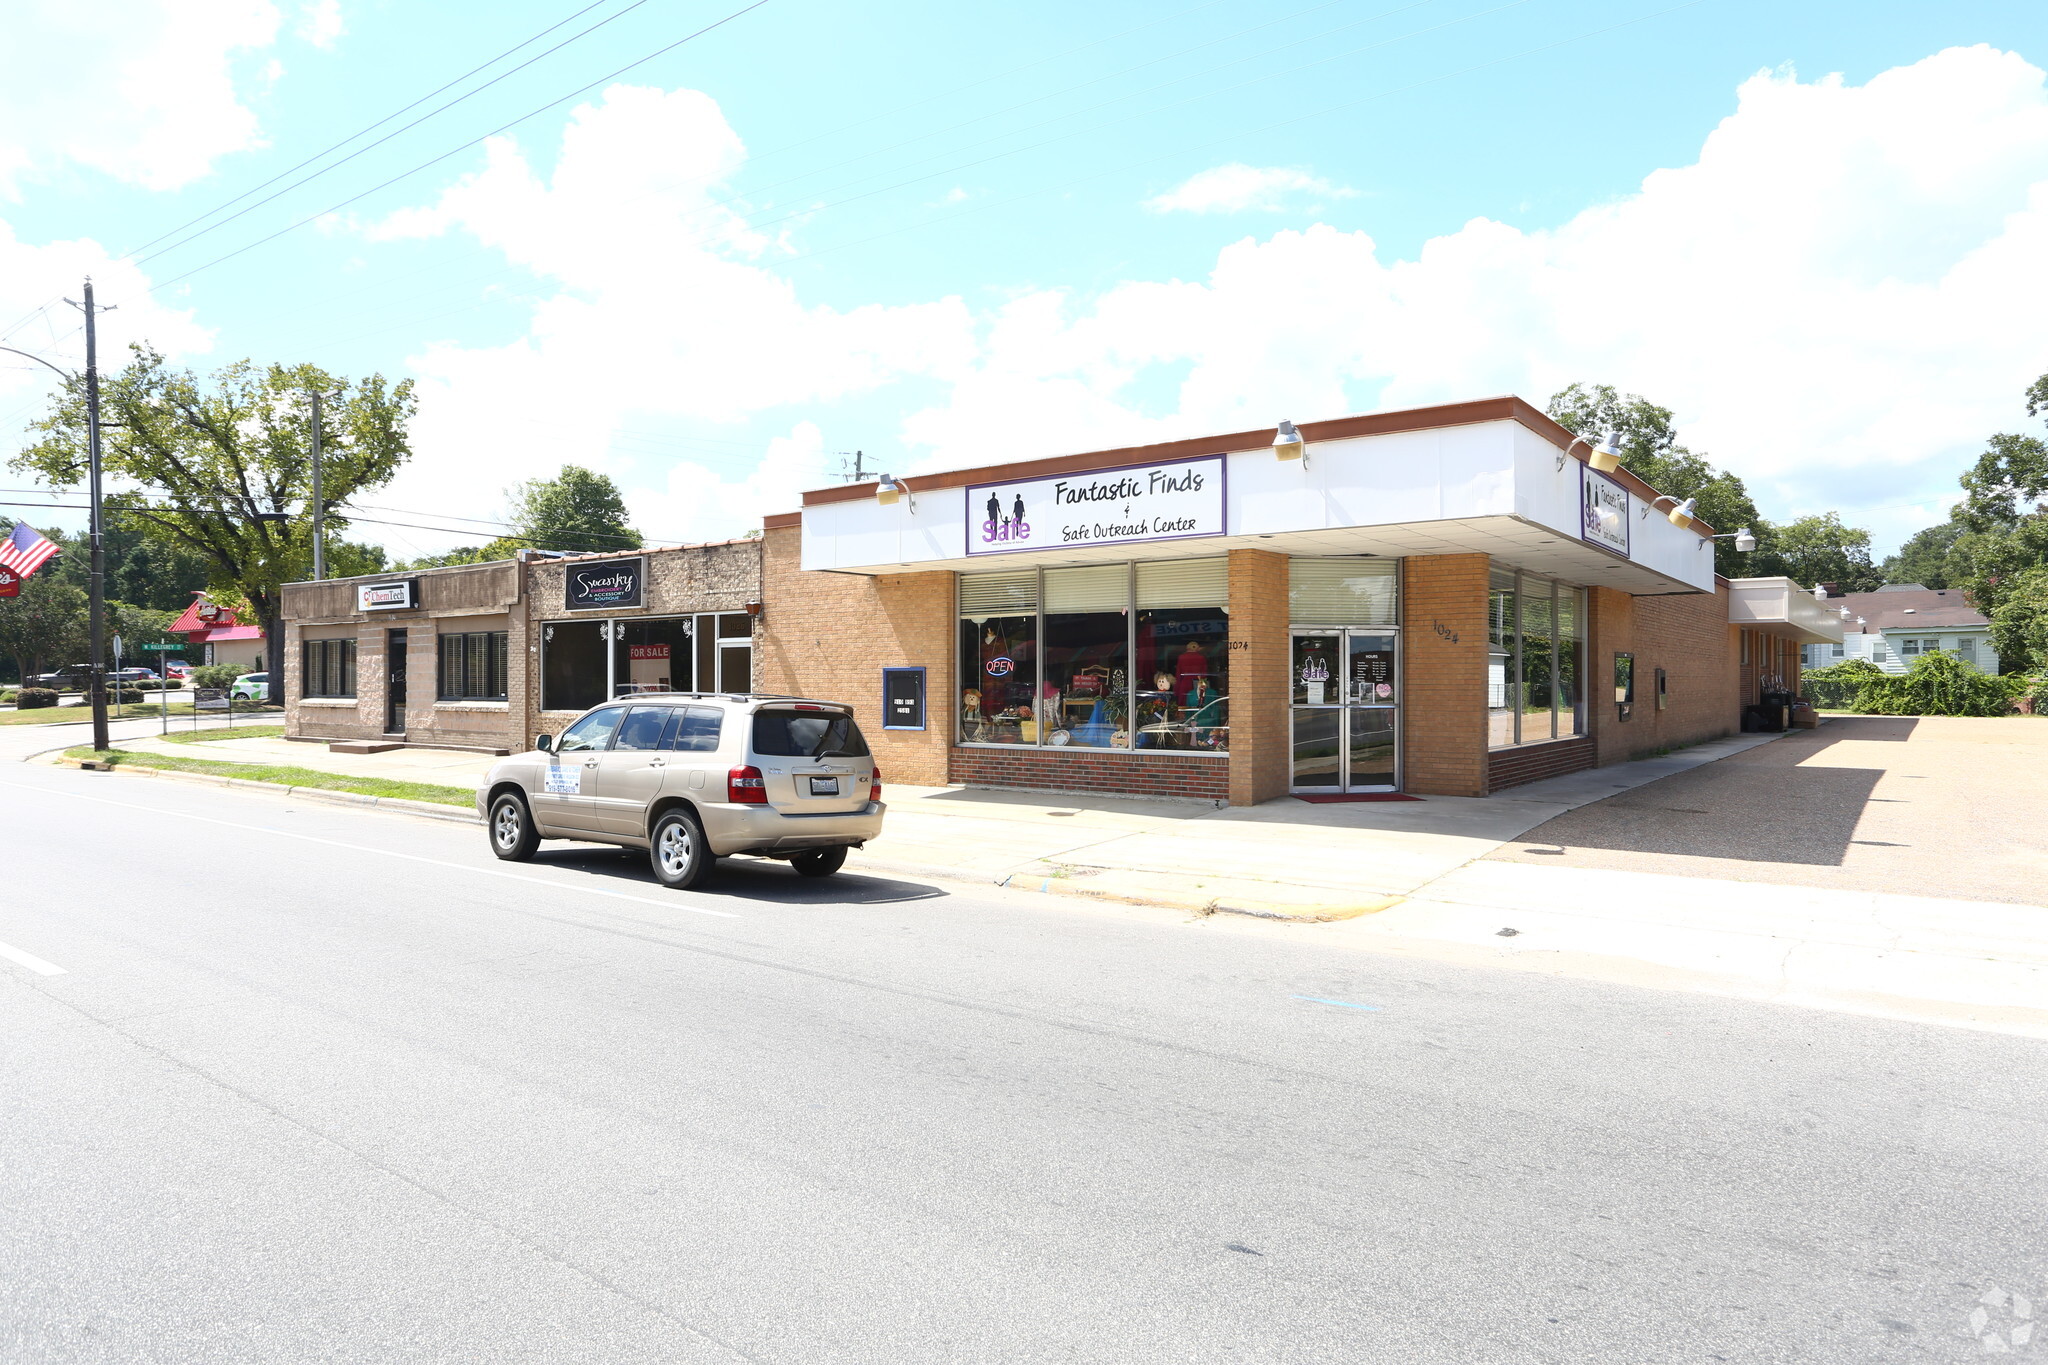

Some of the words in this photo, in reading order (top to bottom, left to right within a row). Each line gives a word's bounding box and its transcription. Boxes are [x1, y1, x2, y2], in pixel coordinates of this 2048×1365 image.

[1055, 478, 1142, 505] Fantastic
[1148, 469, 1204, 495] Finds
[982, 517, 1030, 542] Safe
[1062, 524, 1090, 541] Safe
[372, 589, 404, 602] ChemTech
[577, 572, 633, 598] Swanky
[1433, 619, 1459, 644] 1024
[630, 648, 645, 657] FOR
[646, 647, 669, 657] SALE
[986, 661, 1014, 672] OPEN
